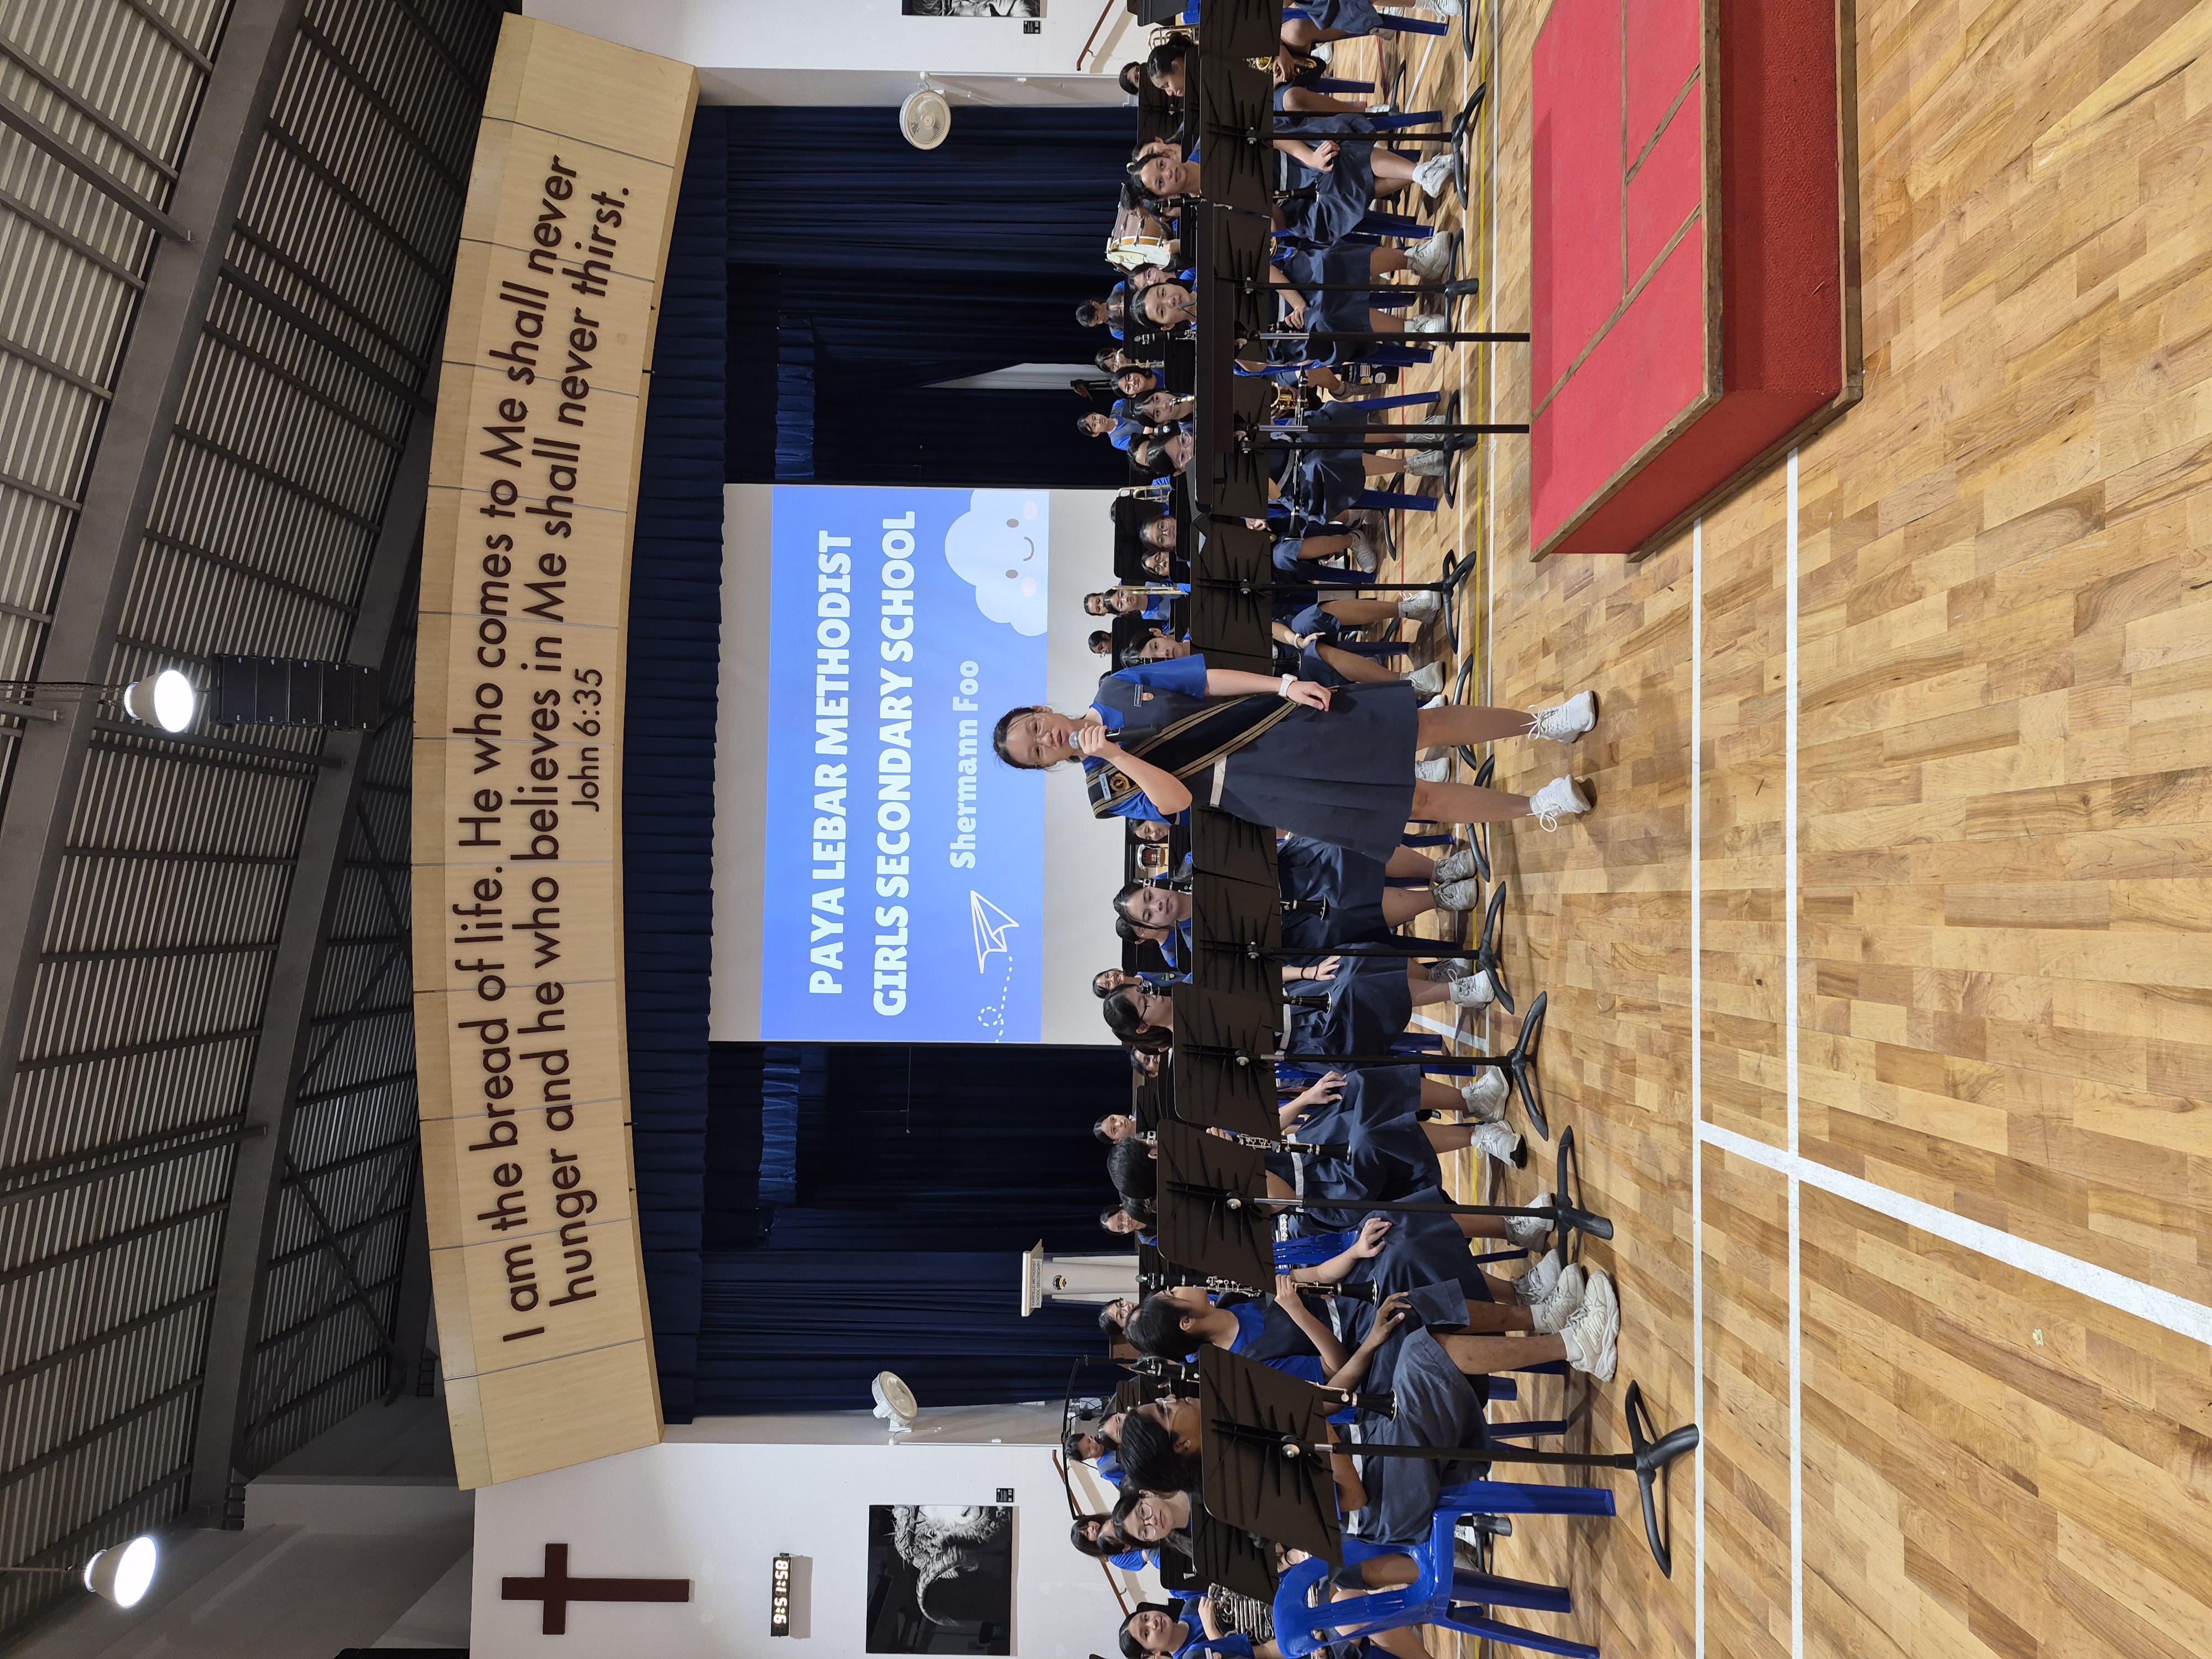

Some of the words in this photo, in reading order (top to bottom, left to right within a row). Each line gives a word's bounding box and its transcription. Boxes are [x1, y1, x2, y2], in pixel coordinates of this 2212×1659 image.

[528, 154, 577, 275] never
[561, 187, 629, 297] thirst.
[488, 280, 549, 385] shall
[557, 306, 599, 427] never
[479, 398, 529, 468] Me
[479, 479, 519, 518] to
[525, 437, 581, 539] shall
[477, 534, 513, 668] comes
[521, 553, 567, 623] Me
[880, 511, 915, 662] SCHOOL
[520, 637, 562, 672] in
[815, 530, 851, 755] METHODIST
[952, 660, 979, 711] Foo
[452, 682, 503, 775] who
[572, 669, 603, 737] 6:35
[458, 789, 503, 846] He
[510, 689, 561, 860] believes
[567, 747, 599, 812] John
[875, 667, 913, 898] SECONDARY
[950, 719, 978, 869] Shermann
[812, 763, 847, 879] LEBAR
[452, 867, 503, 943] life.
[512, 877, 561, 969] who
[809, 887, 845, 994] PAYA
[455, 958, 507, 1001] of
[873, 905, 909, 1016] GIRLS
[517, 982, 565, 1034] he
[458, 1018, 518, 1152] bread
[519, 1049, 574, 1131] and
[477, 1162, 528, 1232] the
[549, 1148, 597, 1307] hunger
[504, 1244, 539, 1312] am
[502, 1327, 545, 1342] I
[773, 1560, 788, 1624] 9:51:58
